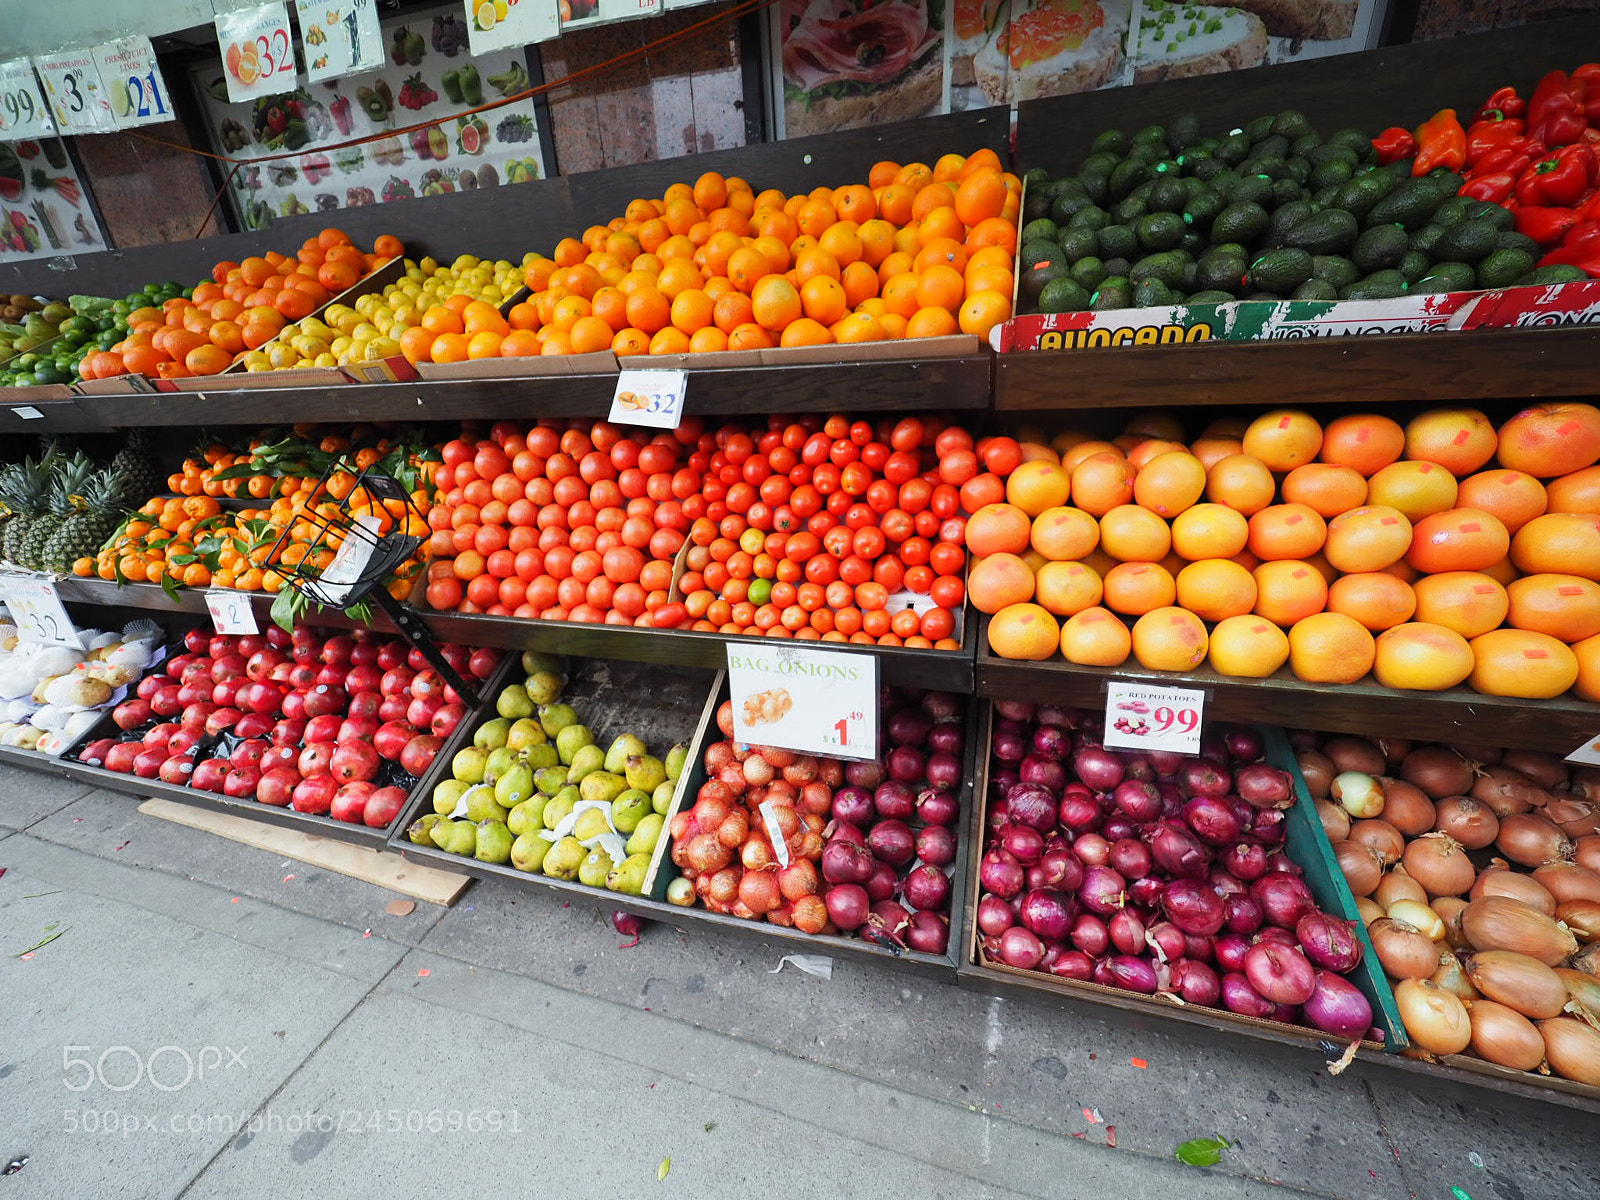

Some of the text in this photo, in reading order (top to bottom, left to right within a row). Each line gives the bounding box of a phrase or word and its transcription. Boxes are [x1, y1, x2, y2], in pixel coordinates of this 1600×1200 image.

[730, 655, 859, 681] BAG ONIONS
[1148, 693, 1197, 702] POTATOES
[1153, 706, 1199, 735] 99
